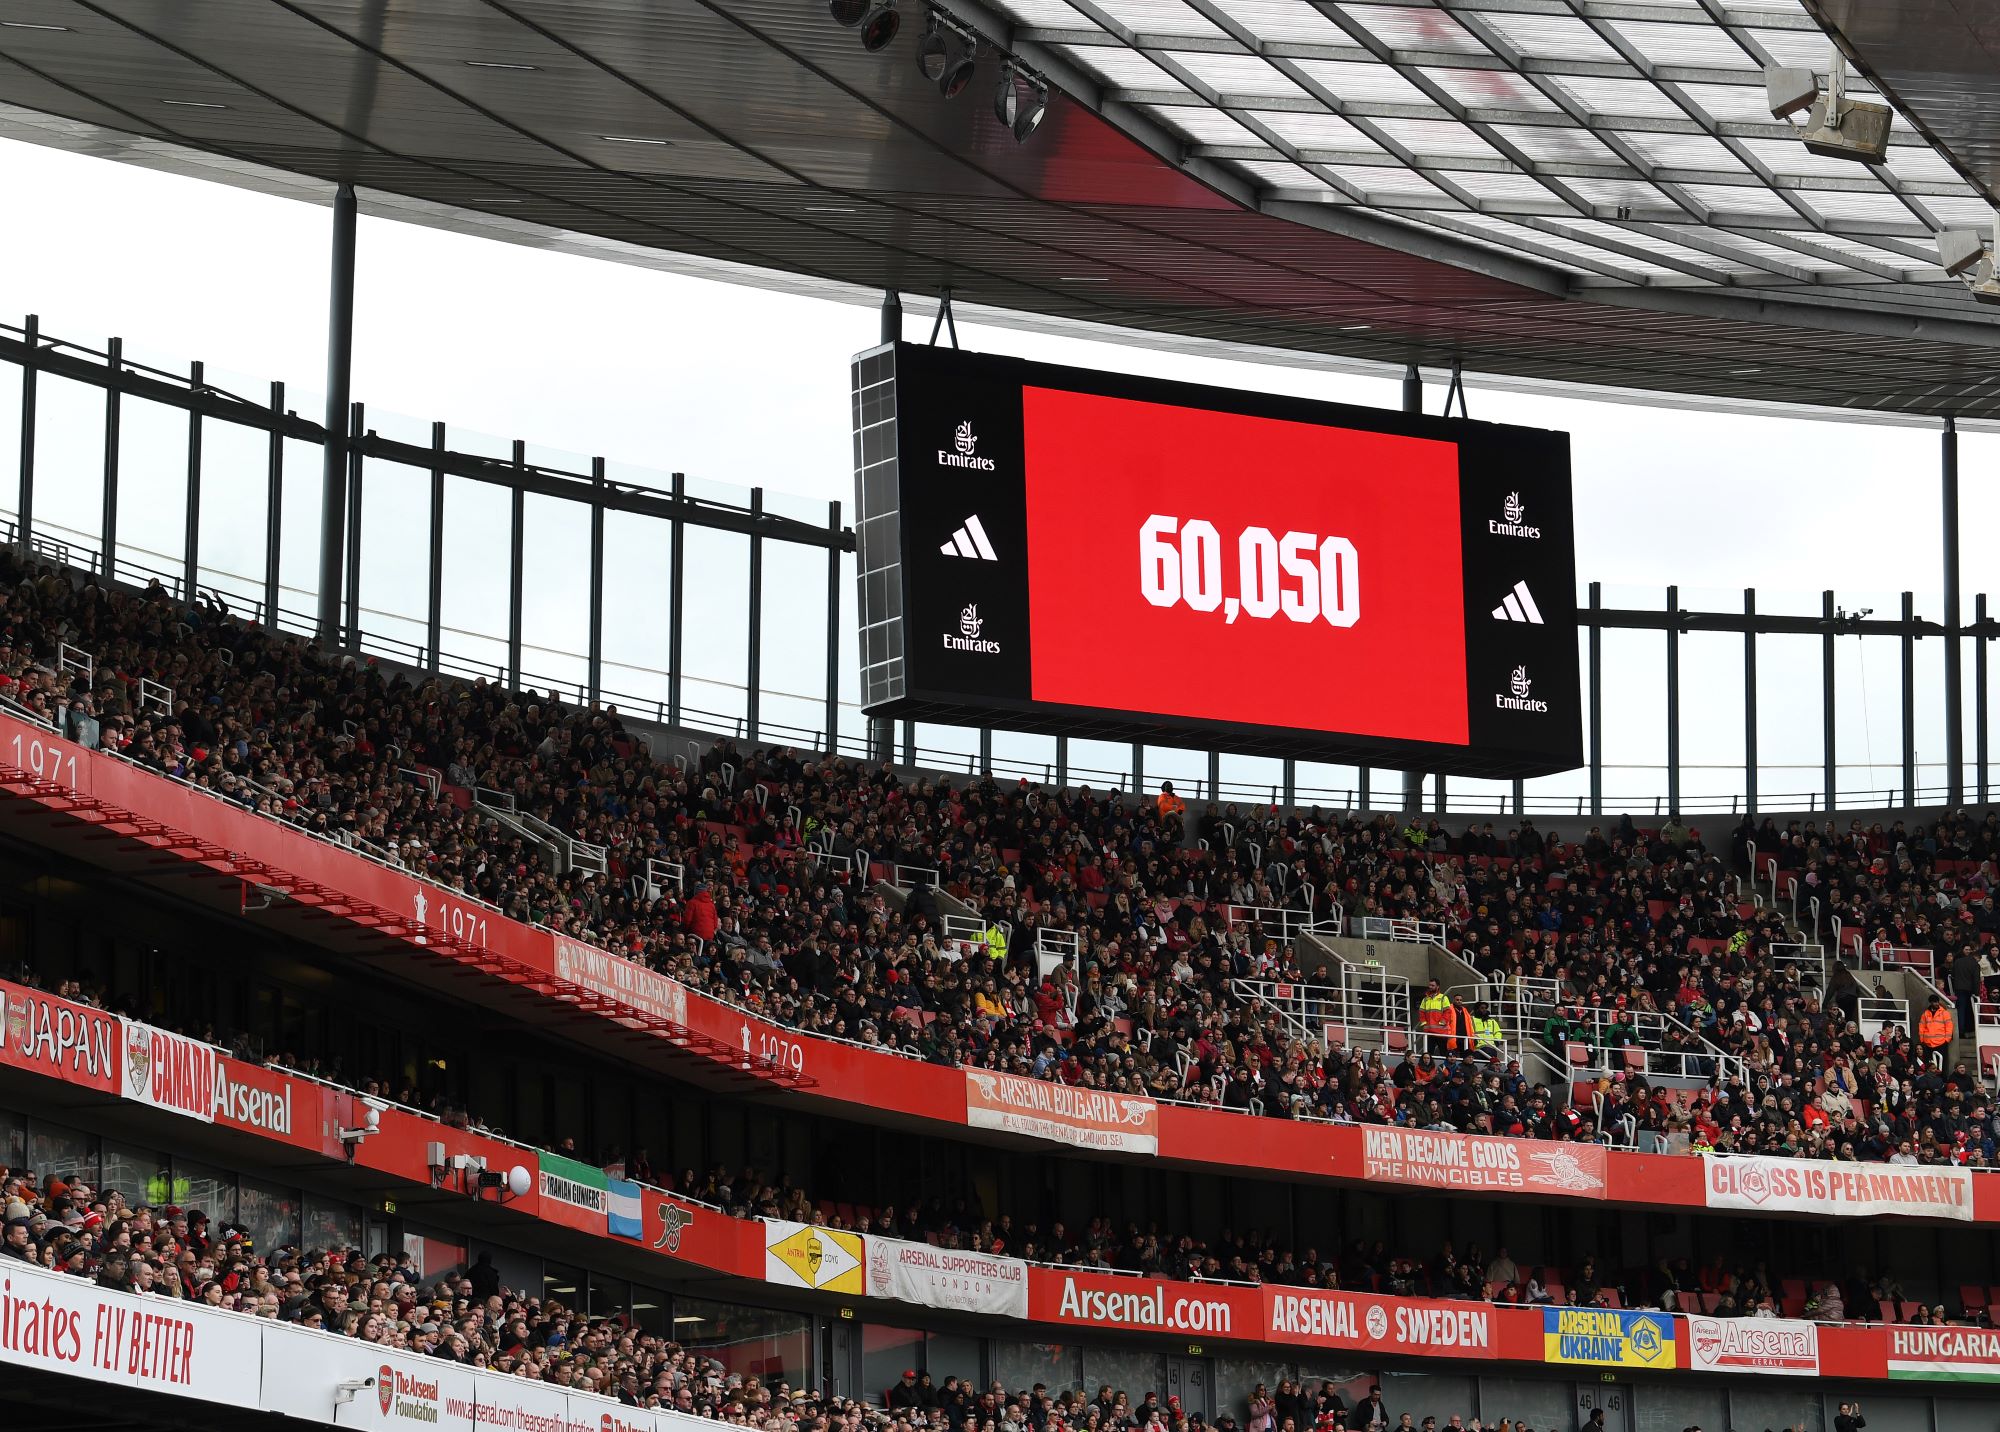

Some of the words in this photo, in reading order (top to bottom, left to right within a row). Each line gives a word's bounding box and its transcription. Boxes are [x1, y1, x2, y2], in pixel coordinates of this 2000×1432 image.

[938, 450, 995, 471] Emirates
[1489, 519, 1541, 539] Emirates
[1139, 514, 1361, 628] 60,050
[943, 633, 1000, 654] Emirates
[1495, 694, 1548, 712] Emirates
[12, 734, 78, 800] 1971
[440, 903, 487, 957] 1971
[1366, 945, 1375, 956] 96
[1873, 975, 1882, 986] 97
[22, 997, 112, 1079] JAPAN
[760, 1032, 803, 1080] 1979
[151, 1031, 212, 1118] CANADA
[214, 1063, 292, 1135] Arsenal
[1000, 1077, 1053, 1113] ARSENAL
[1054, 1087, 1120, 1123] BULGARIA
[1110, 1134, 1124, 1147] SEA
[1366, 1130, 1402, 1159] MEN
[1406, 1133, 1468, 1168] BECAME
[1472, 1140, 1520, 1170] GODS
[1368, 1160, 1403, 1178] THE
[1407, 1163, 1524, 1187] INVINCIBLES
[1804, 1168, 1826, 1200] IS
[1829, 1171, 1966, 1206] PERMANENT
[547, 1175, 572, 1200] IRANIAN
[572, 1184, 600, 1211] GUNNERS
[900, 1248, 940, 1268] ARSENAL
[942, 1255, 998, 1278] SUPPORTERS
[1000, 1264, 1021, 1281] CLUB
[931, 1276, 991, 1295] LONDON
[1059, 1277, 1231, 1332] Arsenal.com
[1272, 1295, 1359, 1338] ARSENAL
[1396, 1306, 1488, 1347] SWEDEN
[1558, 1310, 1624, 1337] ARSENAL
[1696, 1326, 1718, 1335] Arsenal
[93, 1303, 126, 1371] FLY
[128, 1311, 194, 1385] BETTER
[1560, 1335, 1624, 1363] UKRAINE
[1722, 1321, 1816, 1357] Arsenal
[1894, 1330, 2000, 1358] HUNGARIA
[1752, 1358, 1784, 1367] KERALA
[395, 1371, 409, 1395] The
[409, 1374, 438, 1401] Arsenal
[1190, 1371, 1202, 1387] 45
[395, 1395, 438, 1423] Foundation
[1580, 1394, 1592, 1410] 46
[1608, 1395, 1620, 1411] 46
